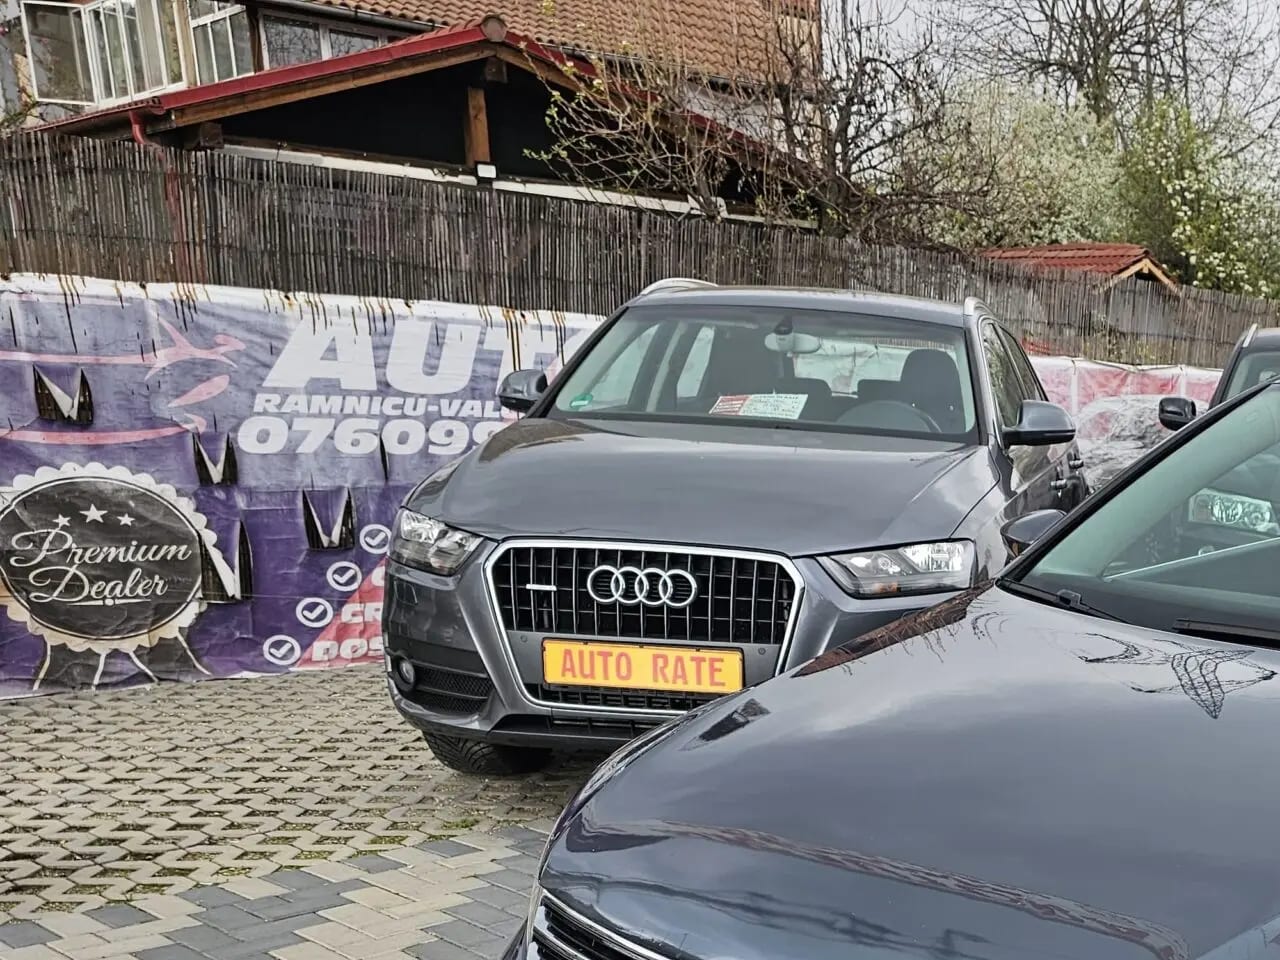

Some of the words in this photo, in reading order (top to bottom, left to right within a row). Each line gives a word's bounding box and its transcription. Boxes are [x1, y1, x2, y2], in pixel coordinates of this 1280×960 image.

[262, 320, 591, 395] AUT
[253, 392, 502, 418] RAMNICU-VAL
[237, 415, 504, 456] 076099
[10, 527, 192, 567] Premium
[28, 564, 168, 603] Dealer
[341, 602, 384, 624] CR
[311, 636, 385, 662] DOS
[561, 648, 633, 681] AUTO
[652, 653, 726, 687] RATE
